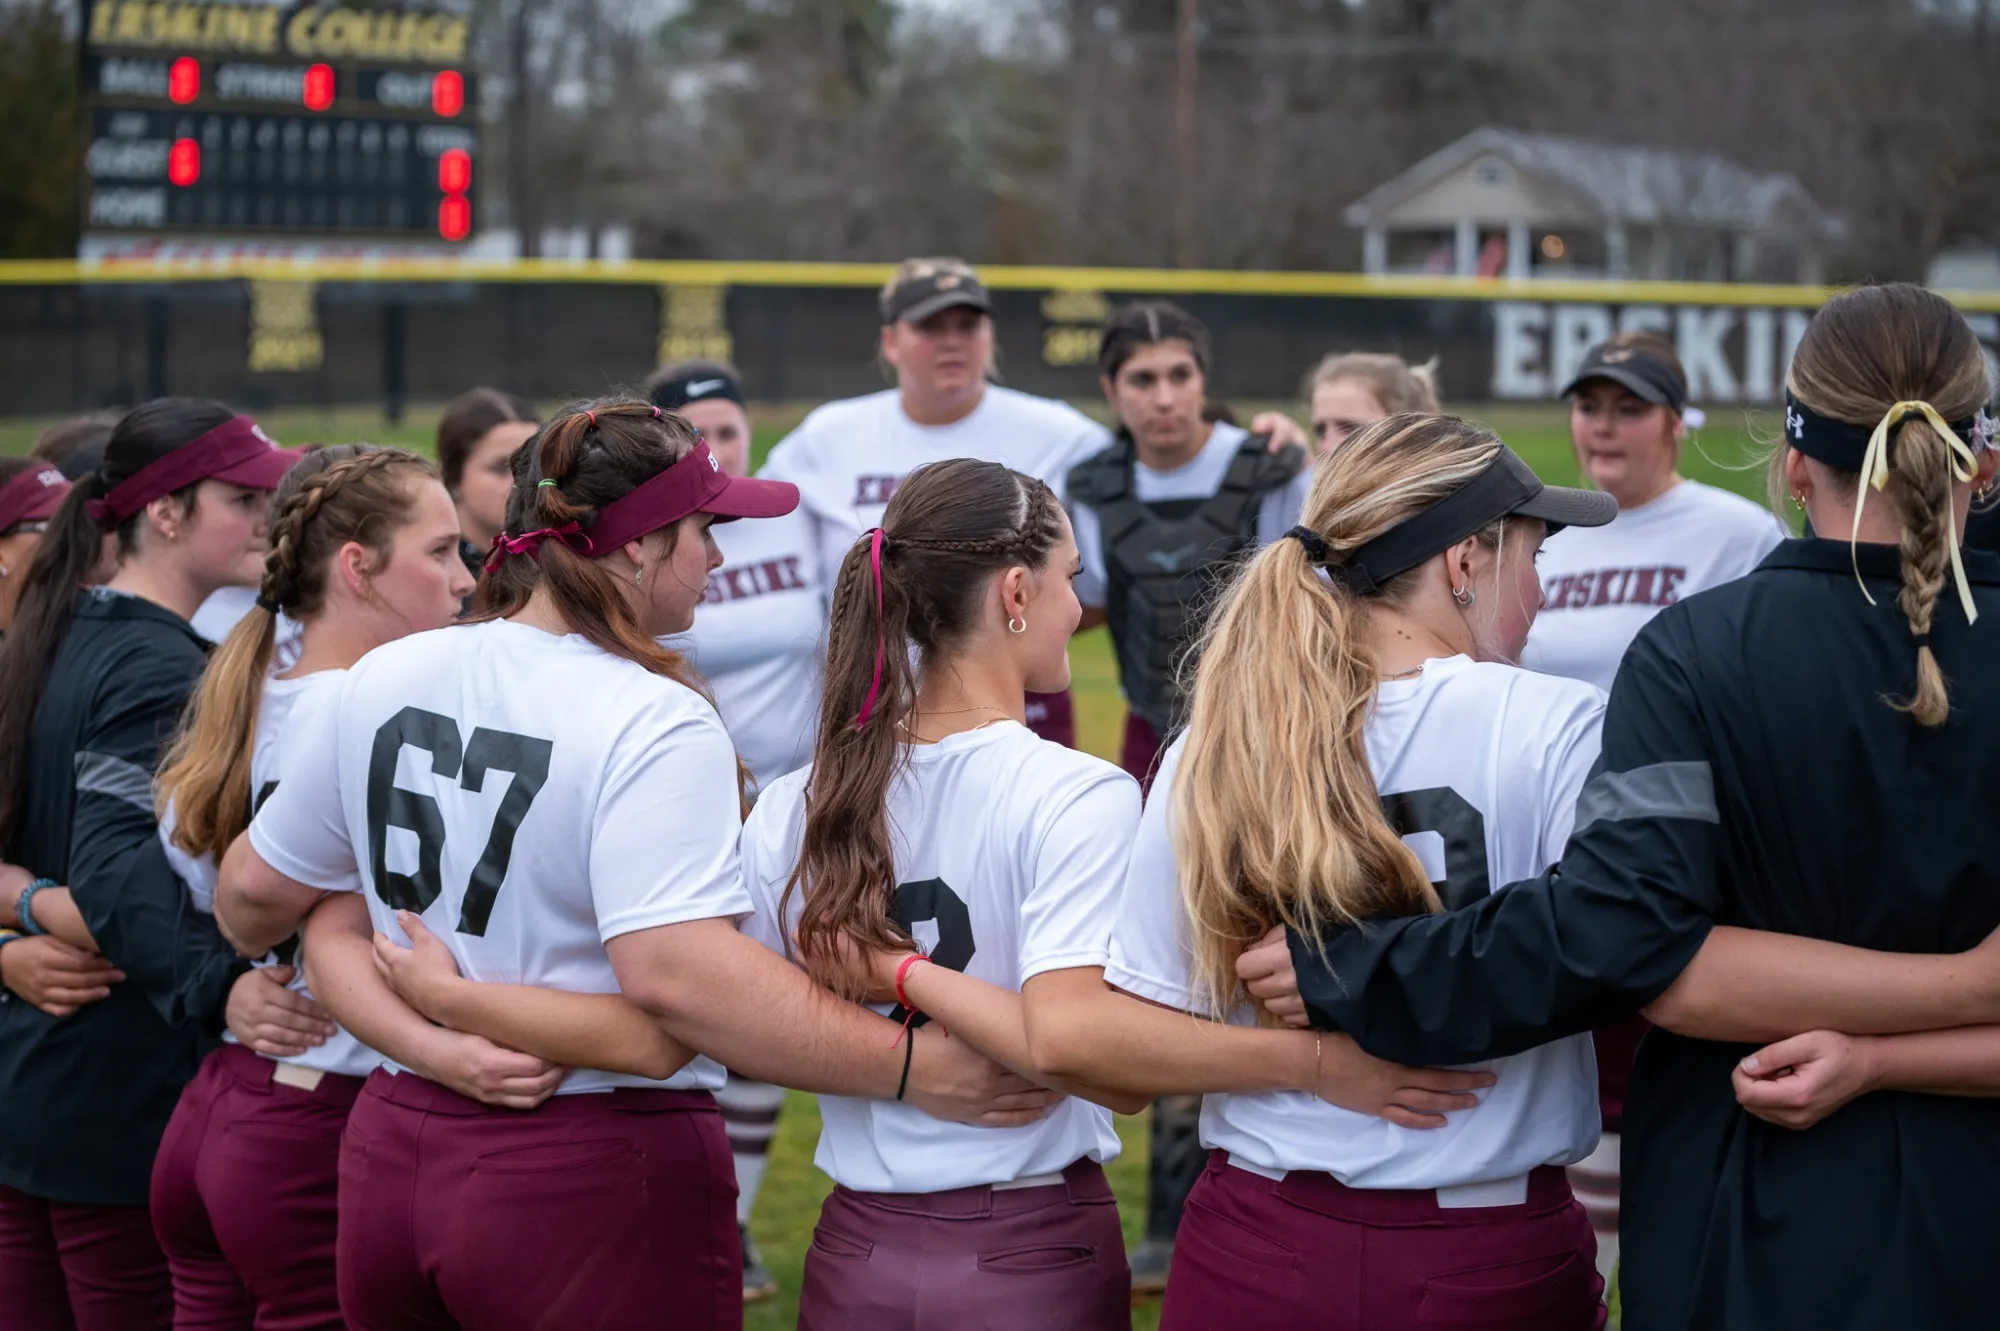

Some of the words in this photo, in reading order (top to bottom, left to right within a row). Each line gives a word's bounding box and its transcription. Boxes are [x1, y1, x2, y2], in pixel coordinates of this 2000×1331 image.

[89, 0, 281, 53] ERSKINE
[287, 7, 468, 61] COLLEGE
[706, 555, 805, 604] SKINE
[366, 705, 554, 938] 67
